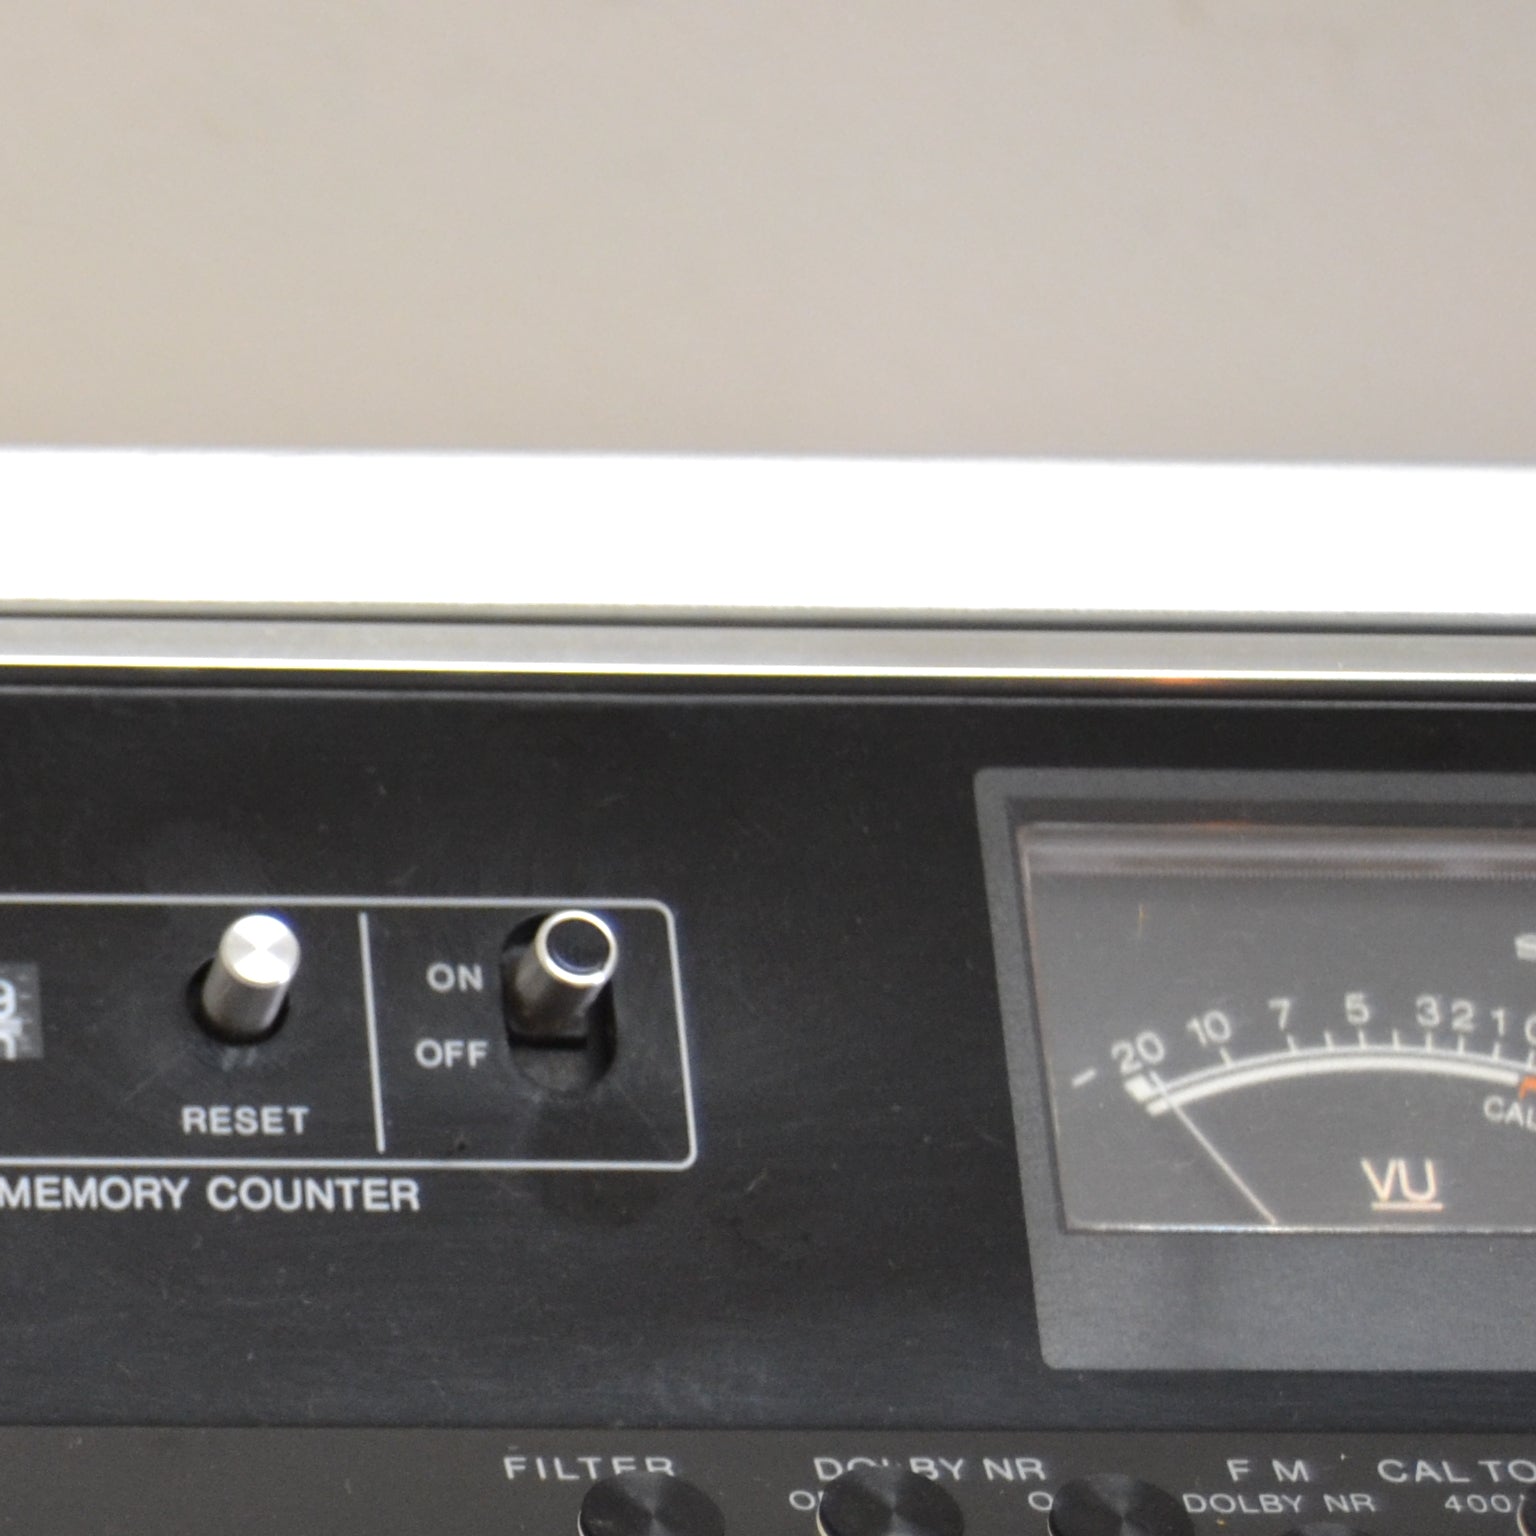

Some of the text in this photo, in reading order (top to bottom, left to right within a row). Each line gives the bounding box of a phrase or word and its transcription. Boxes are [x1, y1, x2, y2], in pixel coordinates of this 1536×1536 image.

[427, 960, 484, 993] ON
[1112, 1030, 1168, 1076] 20
[1187, 1008, 1233, 1048] 10
[1269, 998, 1293, 1031] 7
[1345, 992, 1372, 1026] 5
[1416, 994, 1441, 1028] 3
[1451, 998, 1475, 1032] 2
[1491, 1007, 1506, 1037] 1
[414, 1038, 488, 1070] OFF
[182, 1105, 310, 1138] RESET
[206, 1177, 421, 1214] COUNTER
[1361, 1157, 1440, 1203] VU
[503, 1456, 675, 1481] FILTER
[813, 1456, 1046, 1482] DBY NR
[1377, 1459, 1469, 1484] CAL
[1182, 1493, 1377, 1515] DOLBY NR
